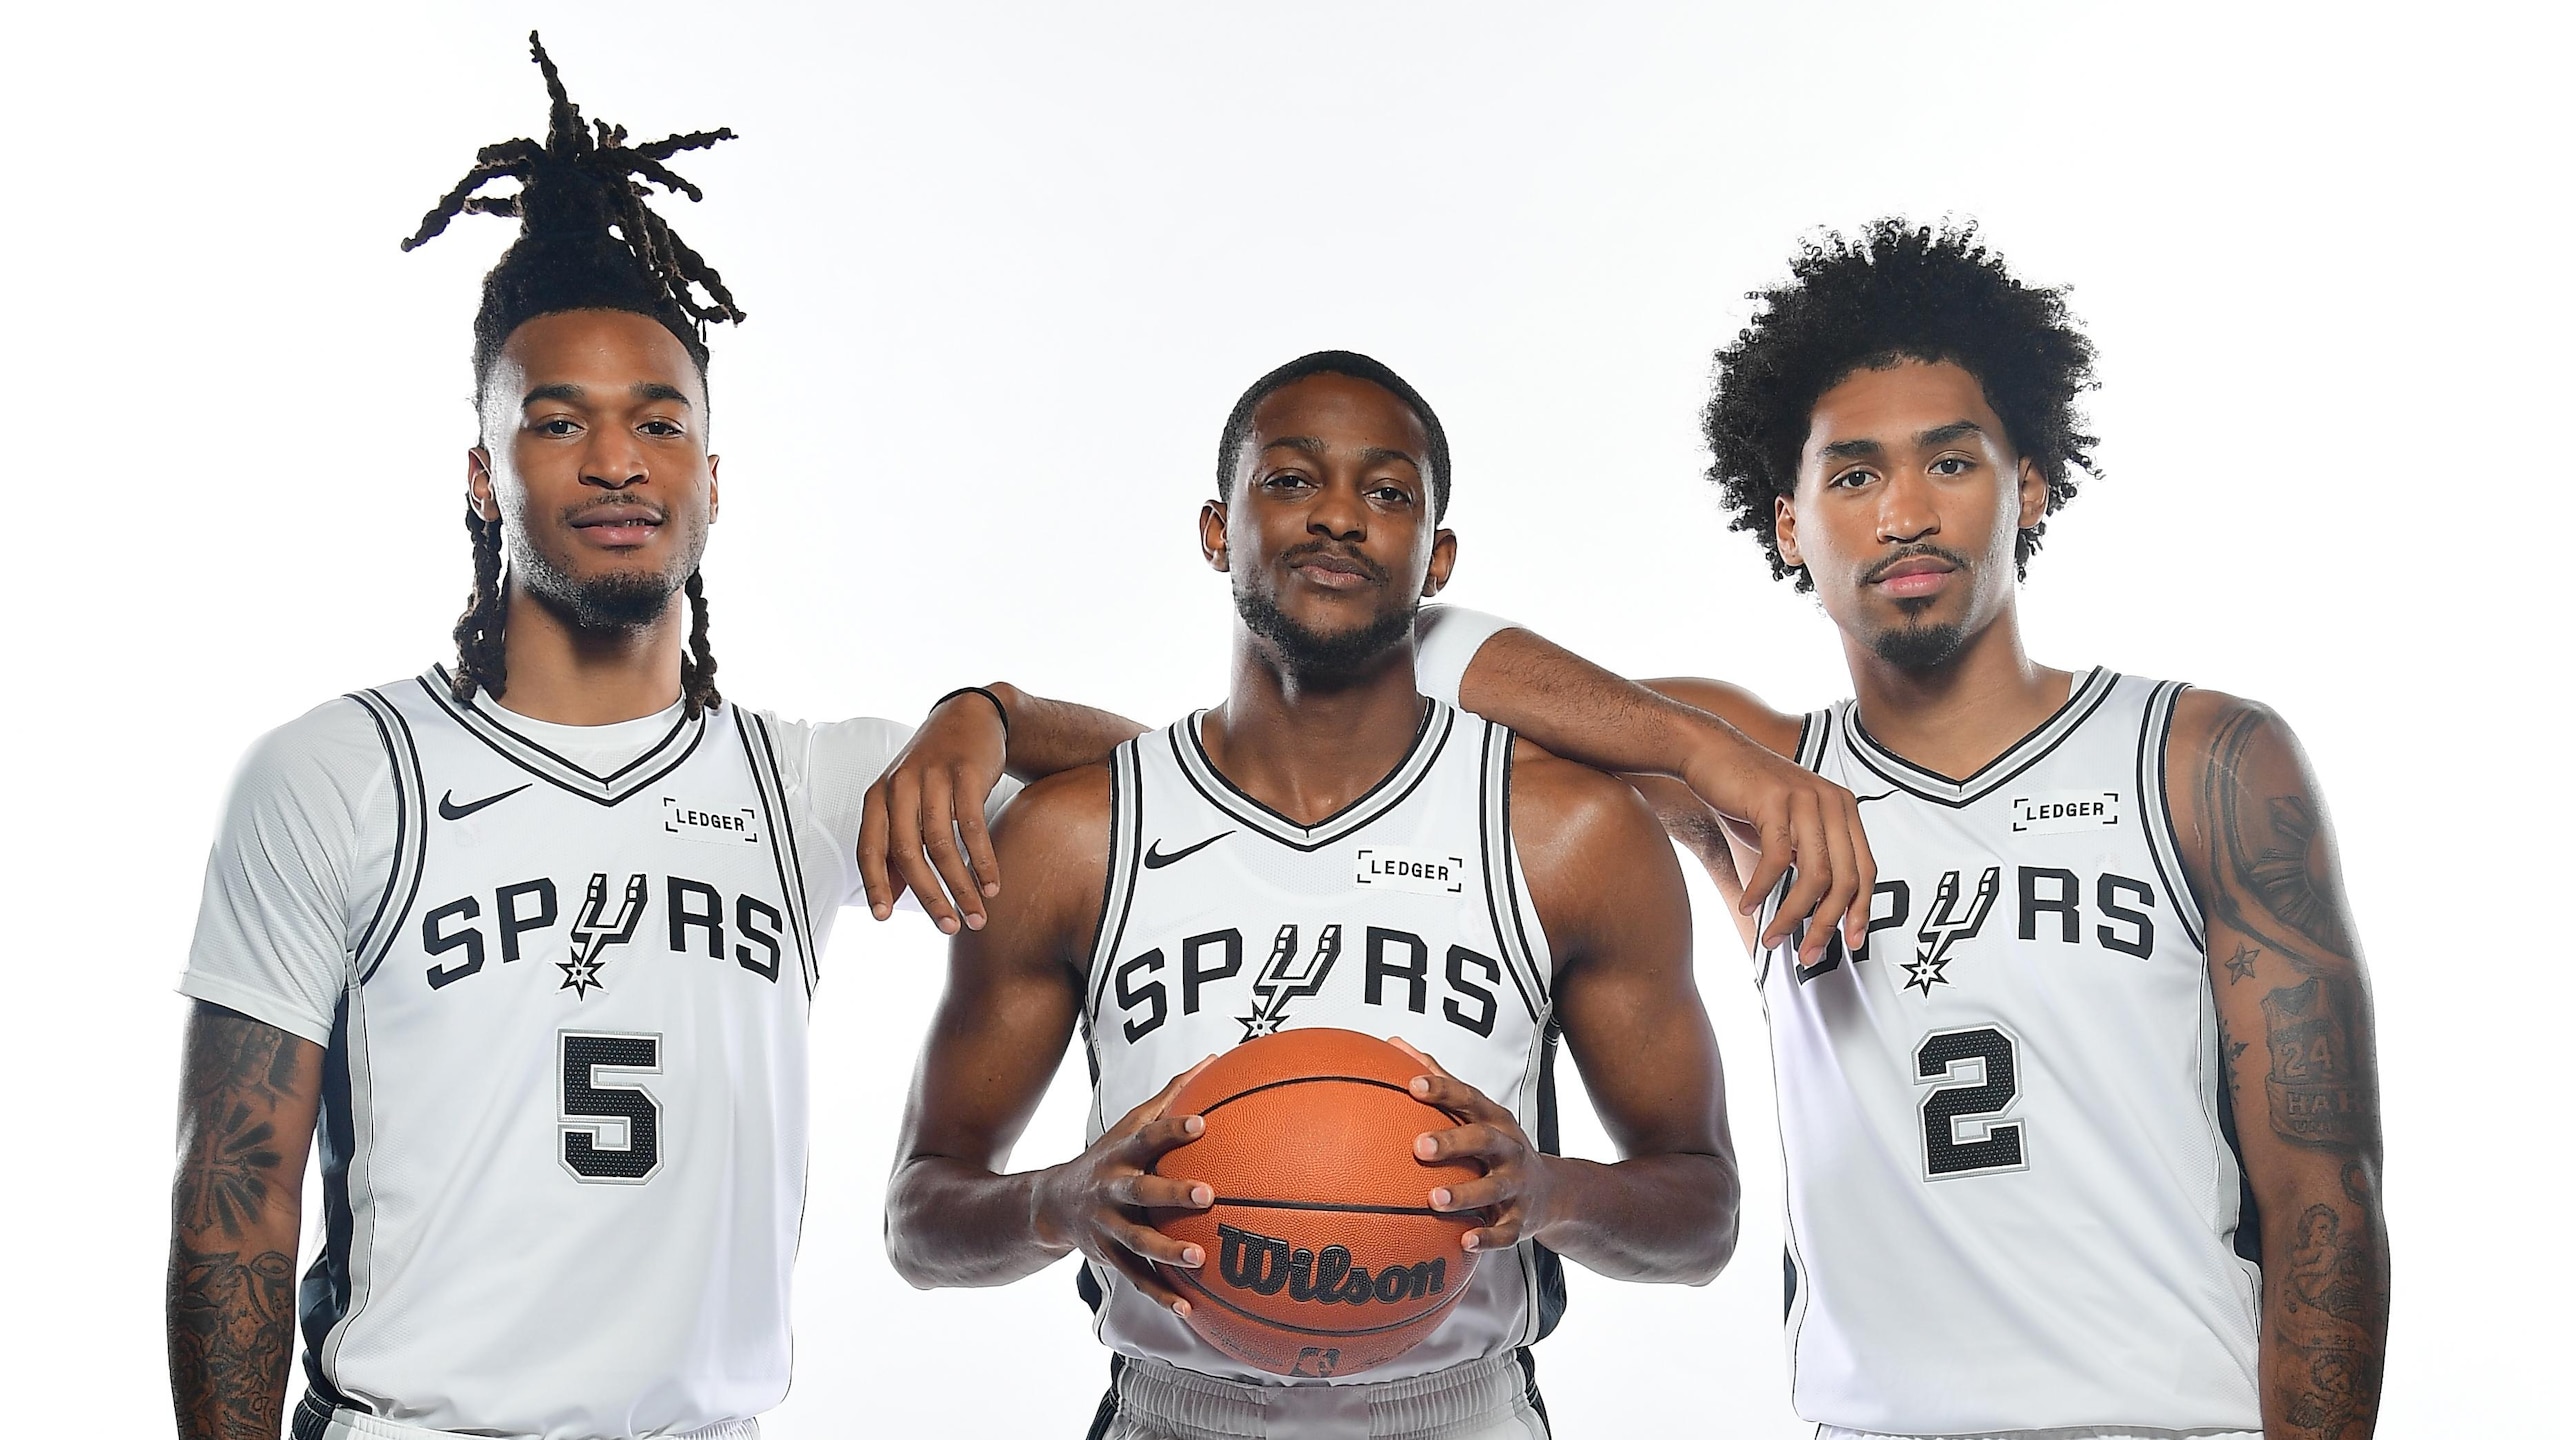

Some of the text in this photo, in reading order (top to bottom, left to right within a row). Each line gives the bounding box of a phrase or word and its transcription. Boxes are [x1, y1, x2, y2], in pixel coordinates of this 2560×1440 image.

[674, 808, 746, 833] LEDGER
[2025, 800, 2106, 822] LEDGER
[1370, 858, 1450, 882] LEDGER
[421, 872, 784, 1003] SPURS
[1113, 923, 1502, 1046] SPURS
[2280, 1035, 2334, 1078] 24
[556, 1028, 664, 1185] 5
[1911, 1020, 2031, 1184] 2
[1216, 1223, 1447, 1305] Wilson
